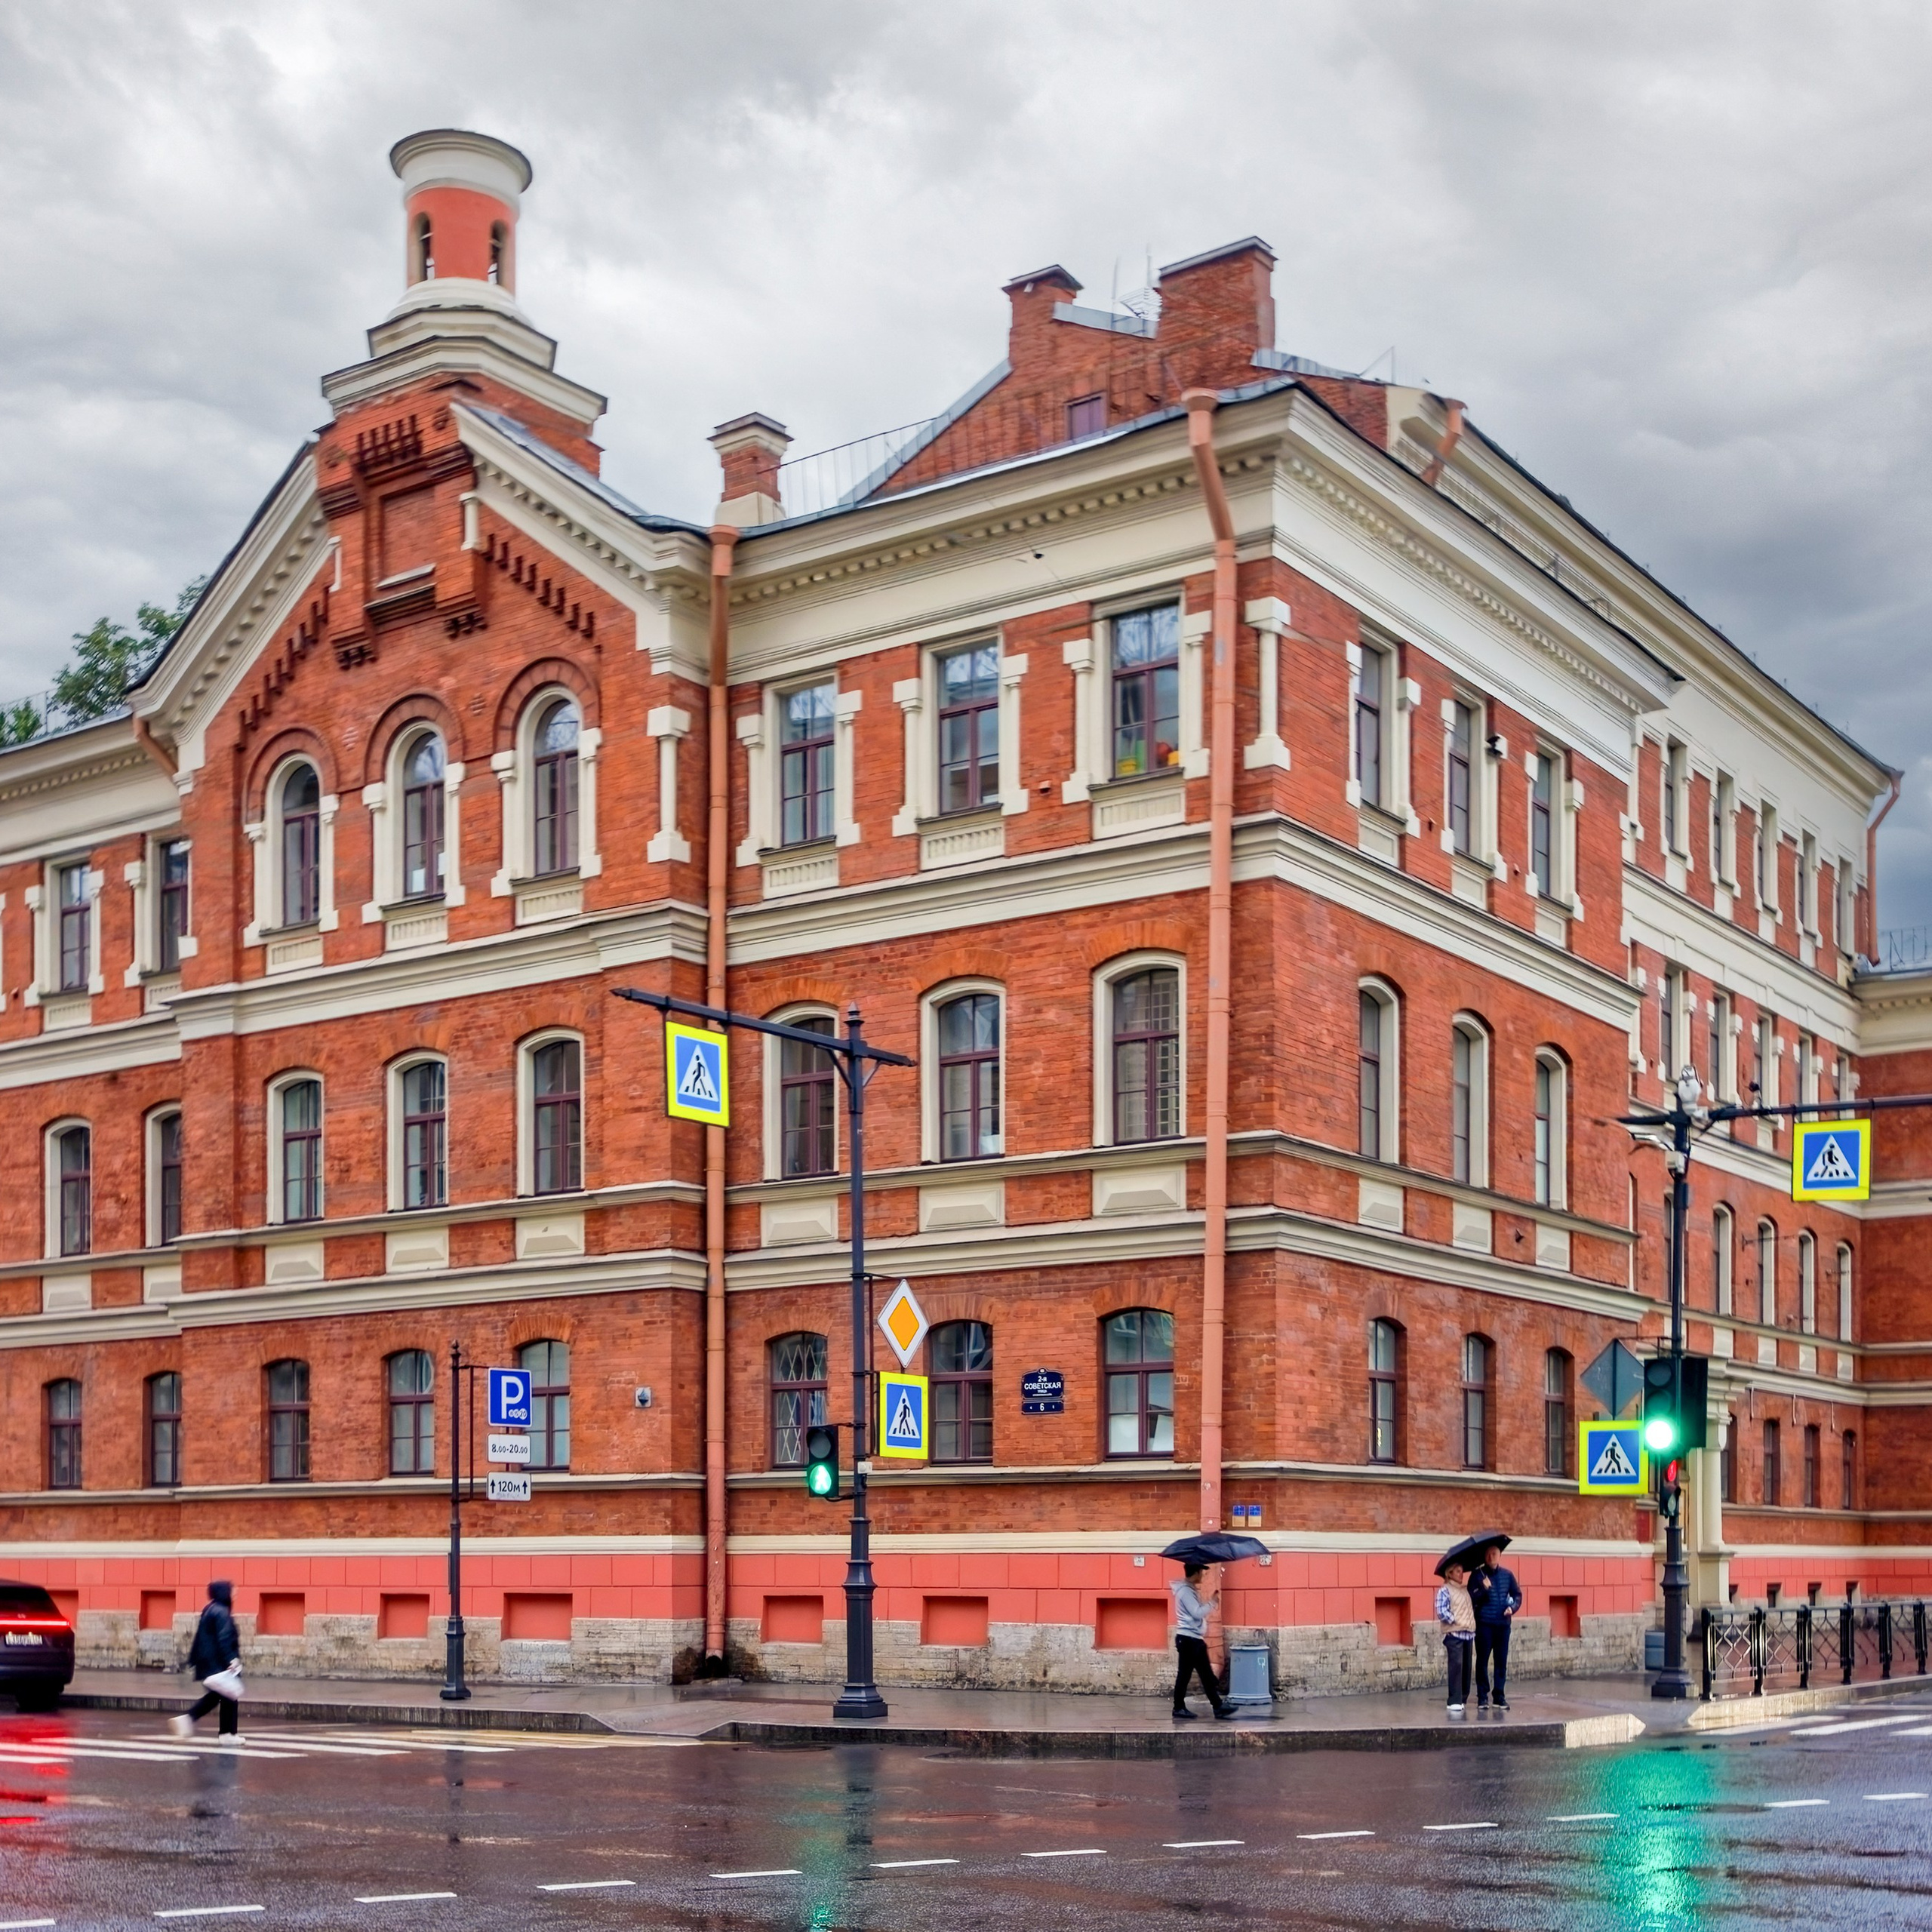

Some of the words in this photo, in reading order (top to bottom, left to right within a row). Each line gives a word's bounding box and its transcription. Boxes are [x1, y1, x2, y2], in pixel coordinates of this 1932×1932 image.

[1024, 1382, 1061, 1390] СОВЕТСКАЯ
[501, 1375, 524, 1420] P
[1039, 1402, 1044, 1411] 6
[491, 1444, 528, 1454] 8.00-20.00
